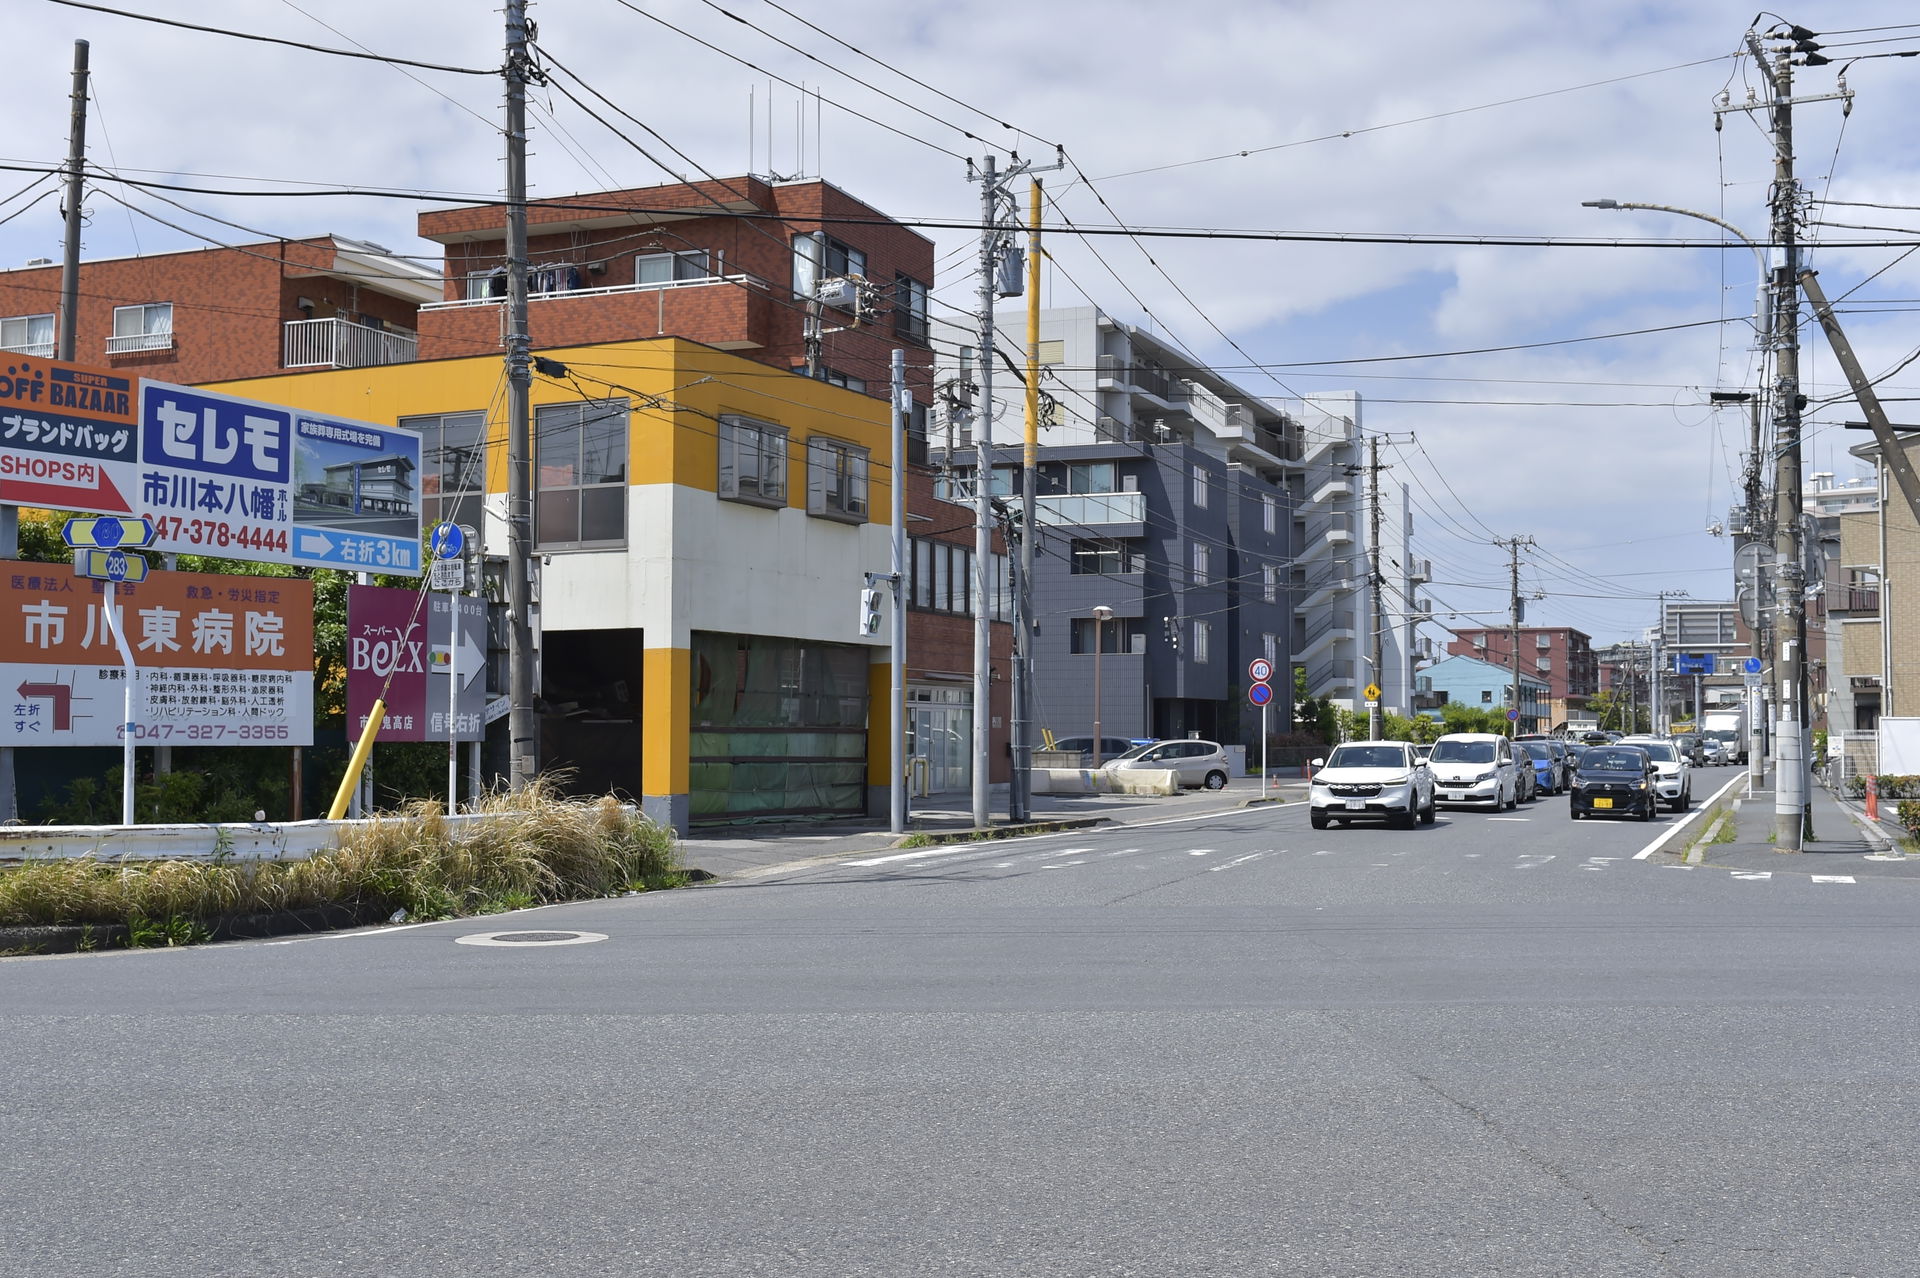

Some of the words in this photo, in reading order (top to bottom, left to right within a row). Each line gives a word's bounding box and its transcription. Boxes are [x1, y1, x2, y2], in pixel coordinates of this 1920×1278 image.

[73, 372, 108, 387] SUPER
[51, 382, 129, 416] BAZAAR
[3, 414, 129, 454] ブランドバッグ
[156, 400, 280, 473] セレモ
[300, 420, 381, 448] 家族葬専用式場を完備
[1, 455, 94, 483] SHOPS内
[142, 471, 275, 521] 市川本八幡
[277, 488, 288, 522] ホール
[108, 556, 126, 576] 283
[11, 575, 73, 593] 医療法人
[186, 585, 280, 604] 救急・労災指定
[21, 599, 286, 657] 市川東病院
[363, 624, 393, 637] スーパー
[1254, 665, 1268, 676] 40
[13, 703, 41, 718] 左折
[14, 721, 41, 734] すぐ
[359, 714, 414, 732] 市鬼高店
[134, 725, 289, 741] 047-327-3355
